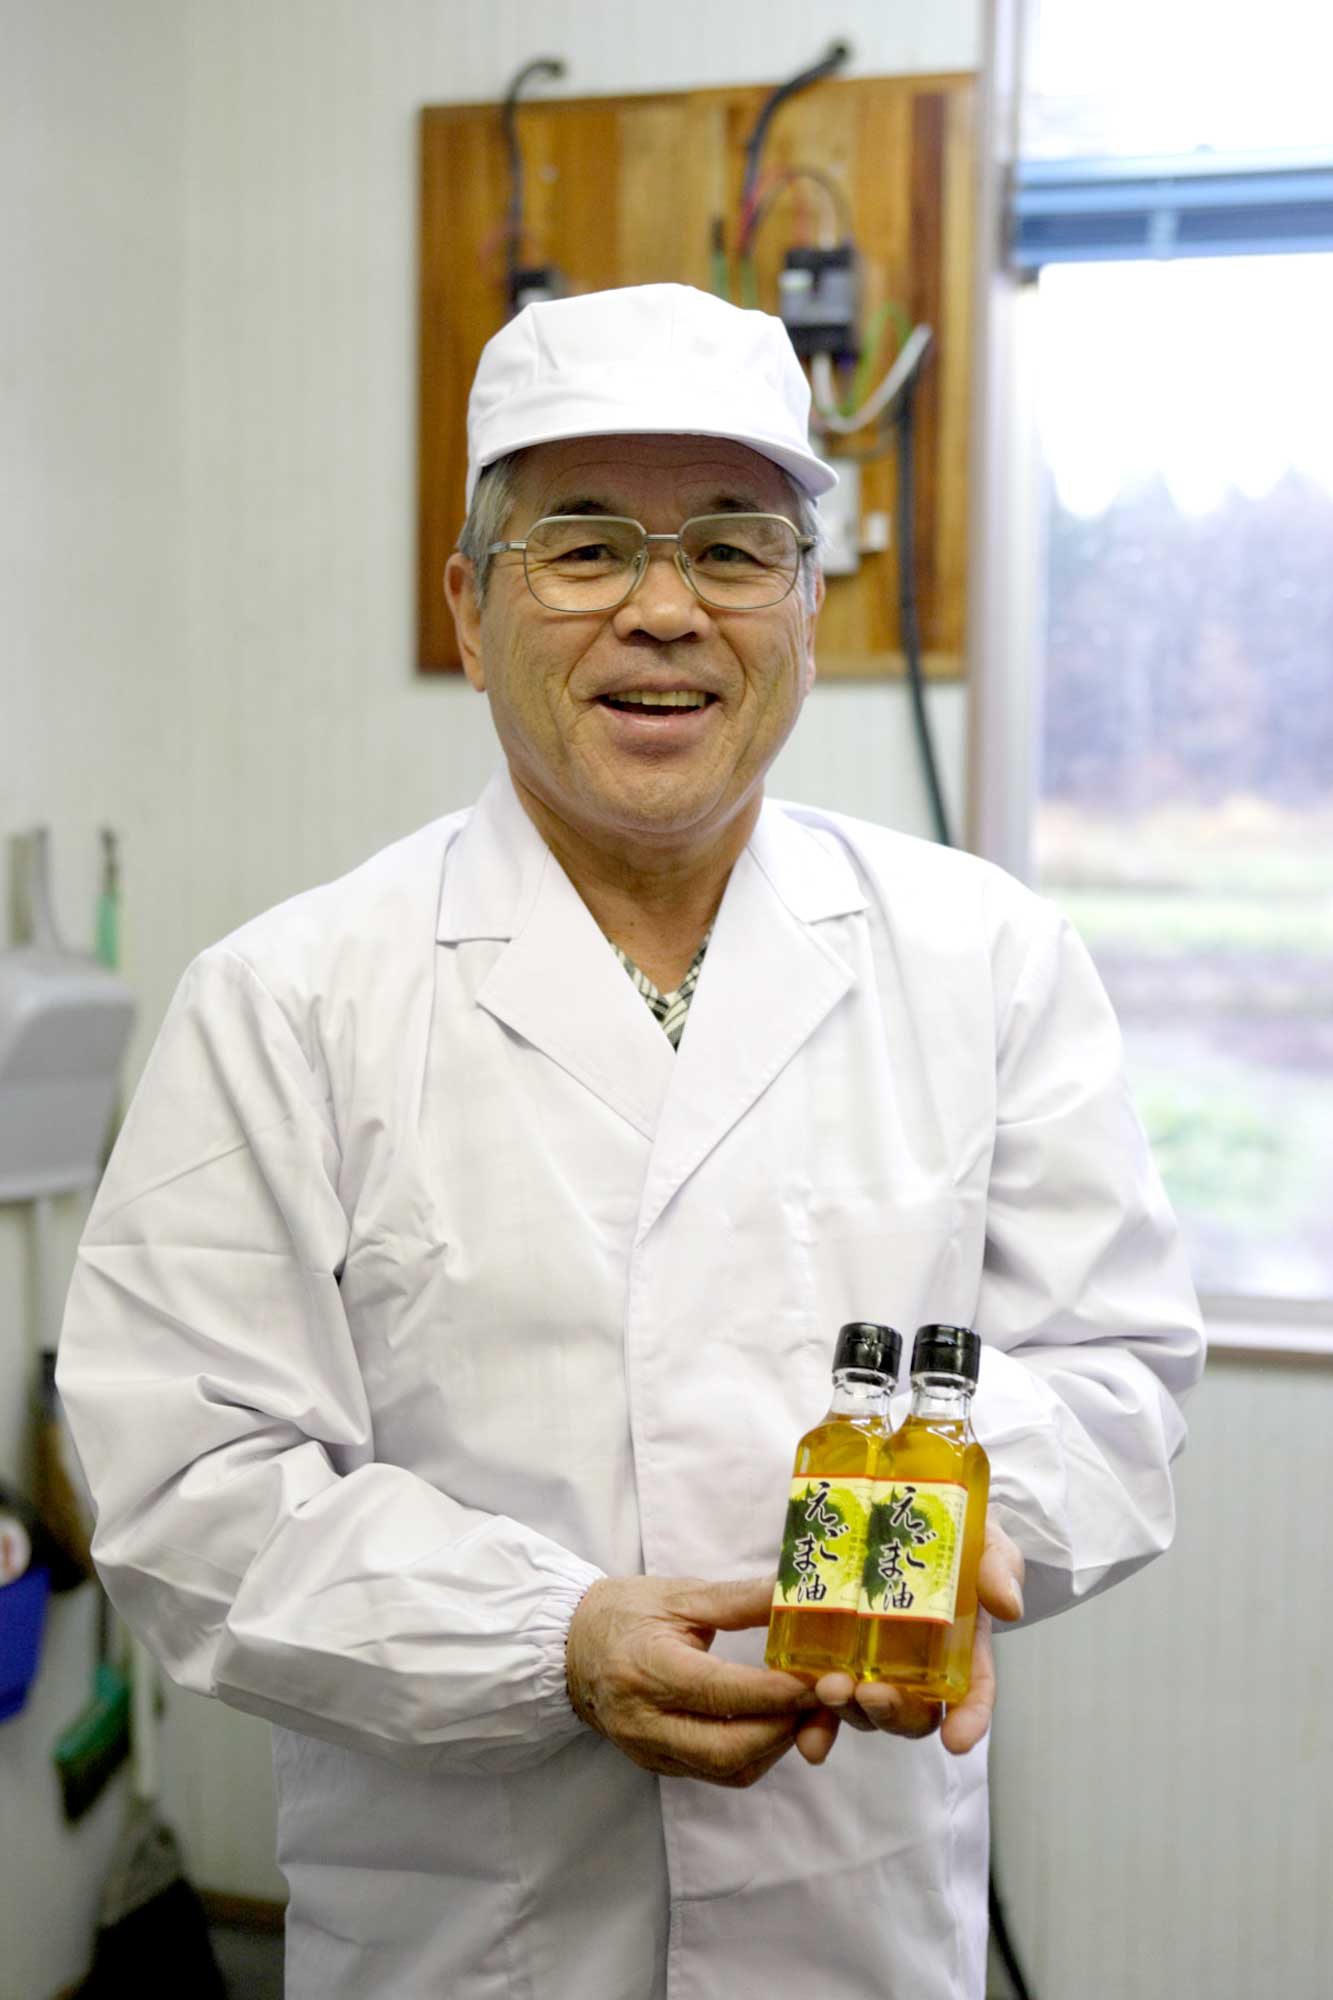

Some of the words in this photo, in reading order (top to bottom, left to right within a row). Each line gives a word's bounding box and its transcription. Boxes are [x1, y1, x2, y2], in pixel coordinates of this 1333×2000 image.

[794, 1481, 849, 1603] えごま油
[880, 1486, 937, 1611] えごま油
